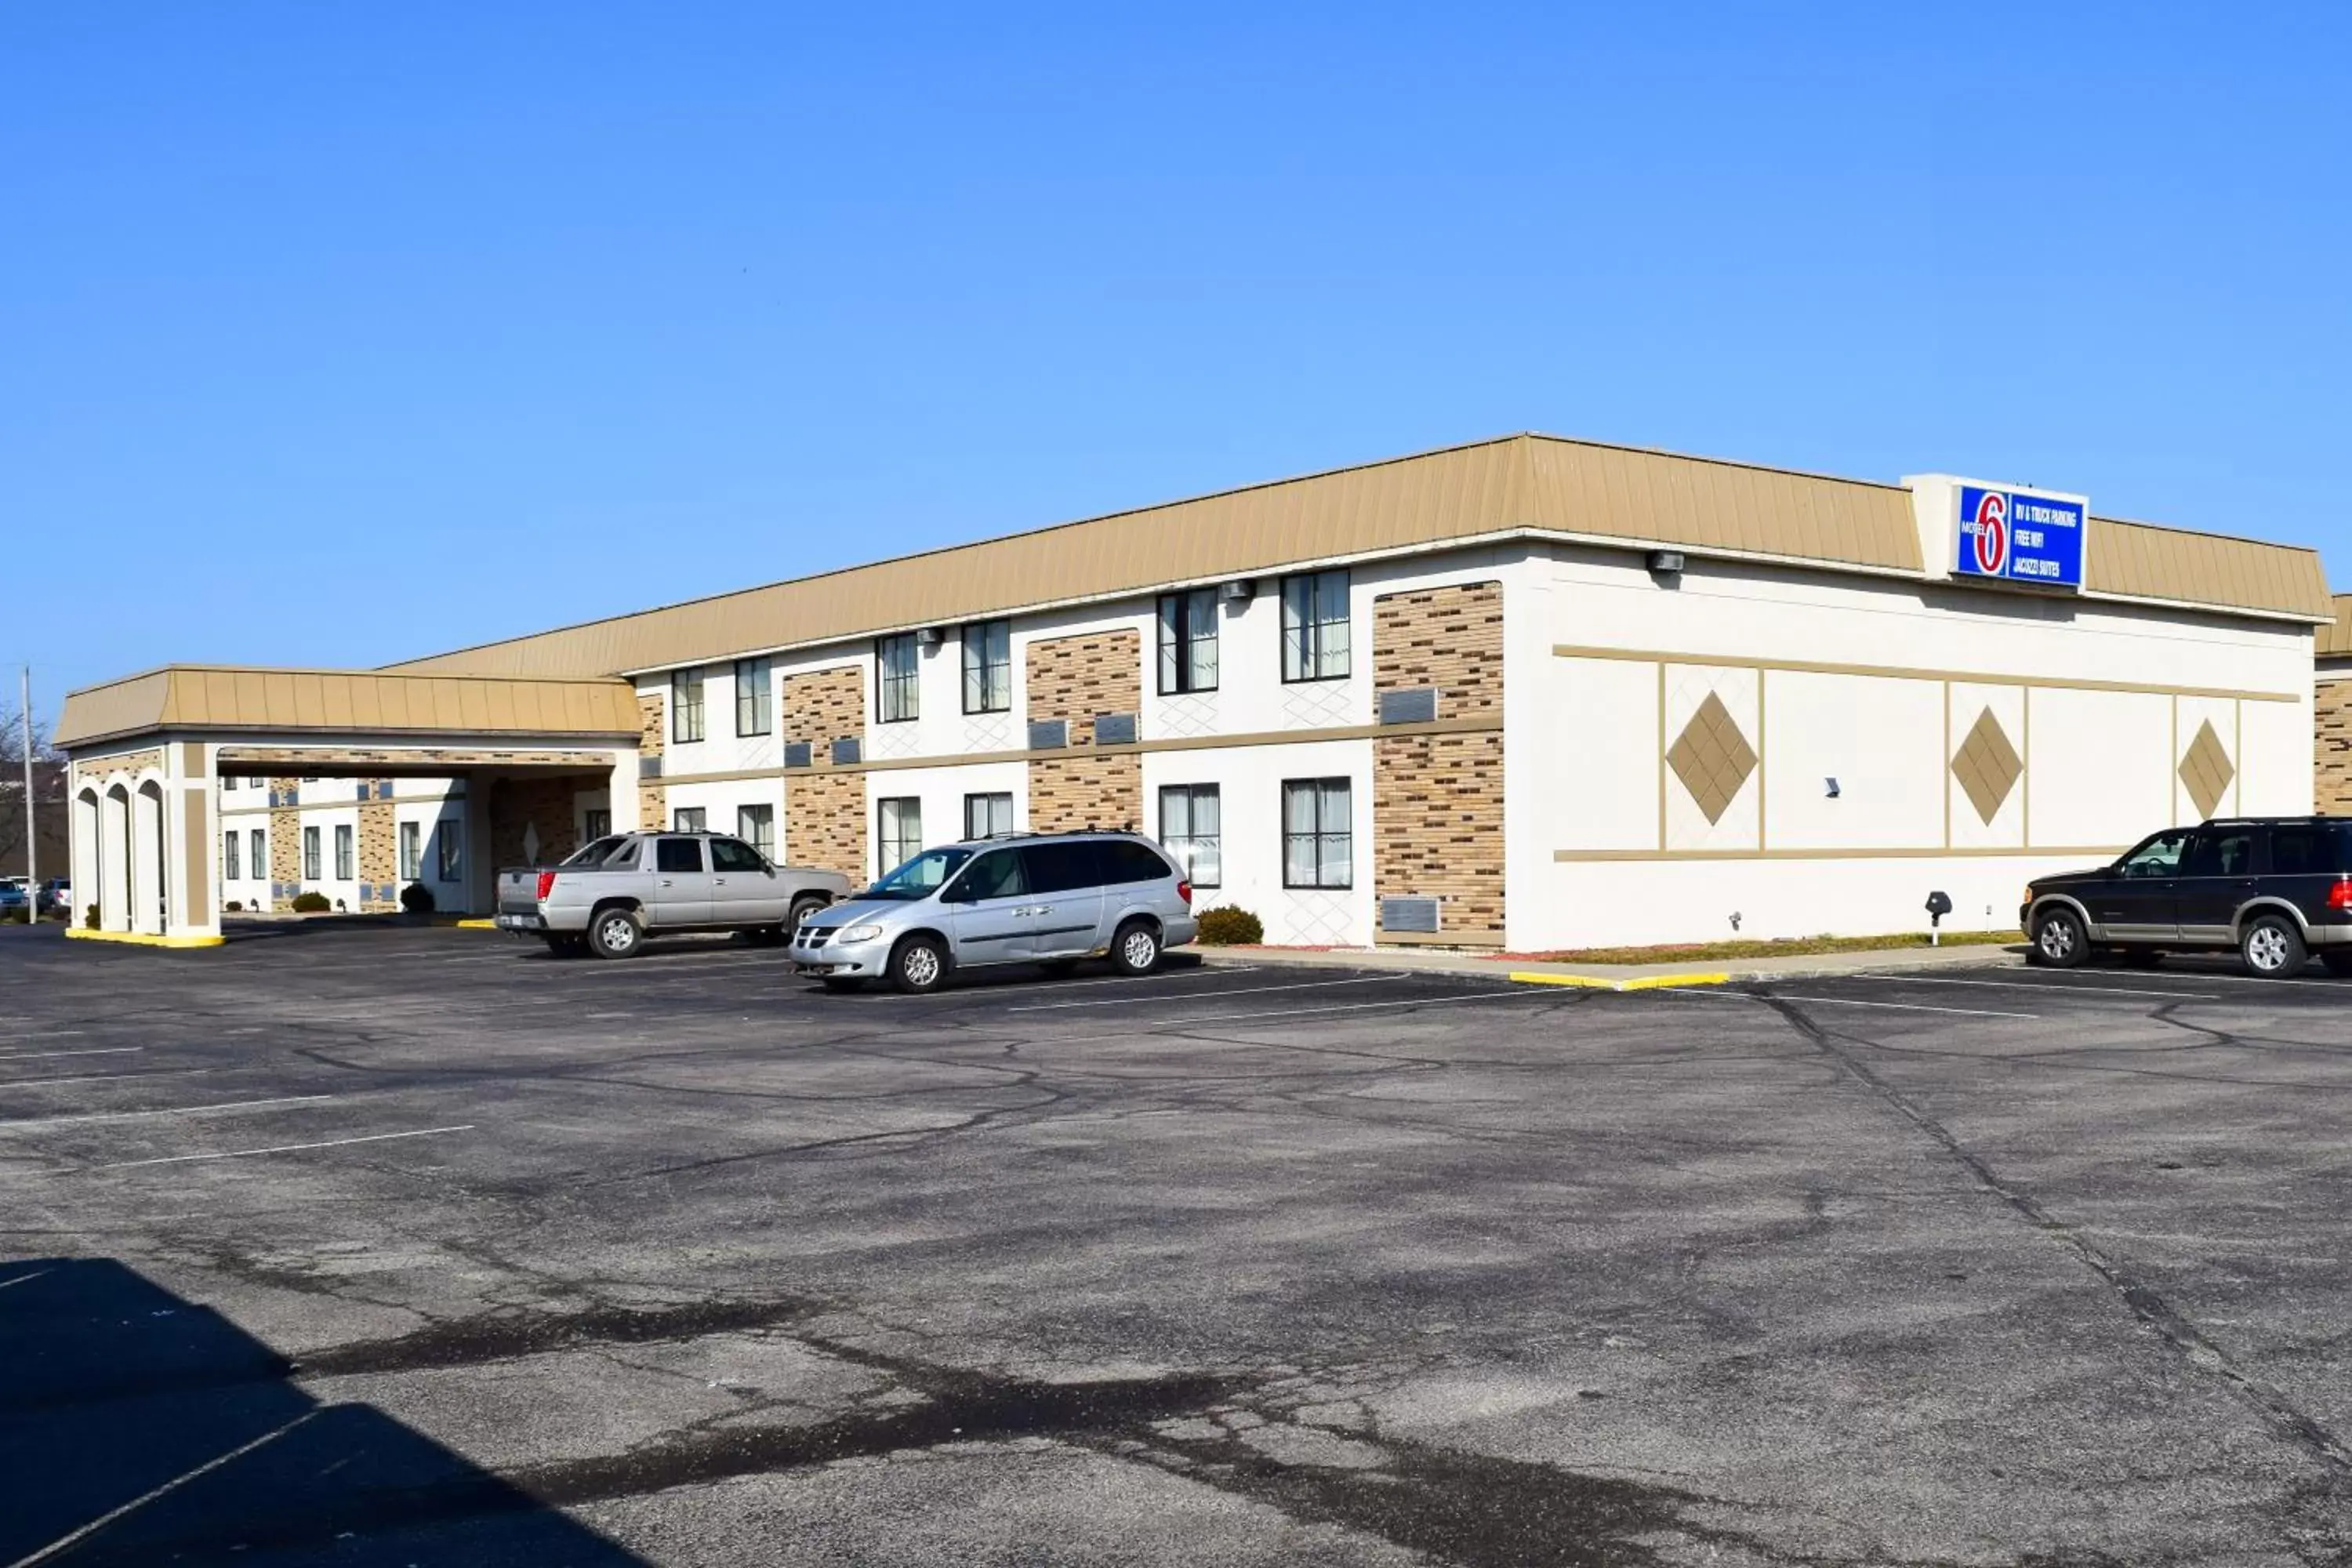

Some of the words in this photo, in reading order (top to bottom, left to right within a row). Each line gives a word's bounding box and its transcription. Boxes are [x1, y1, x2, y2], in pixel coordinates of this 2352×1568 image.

[1962, 521, 1986, 535] MOTEL
[1975, 493, 2005, 573] 6
[2014, 529, 2030, 546] FREE
[2039, 560, 2060, 577] SUITES
